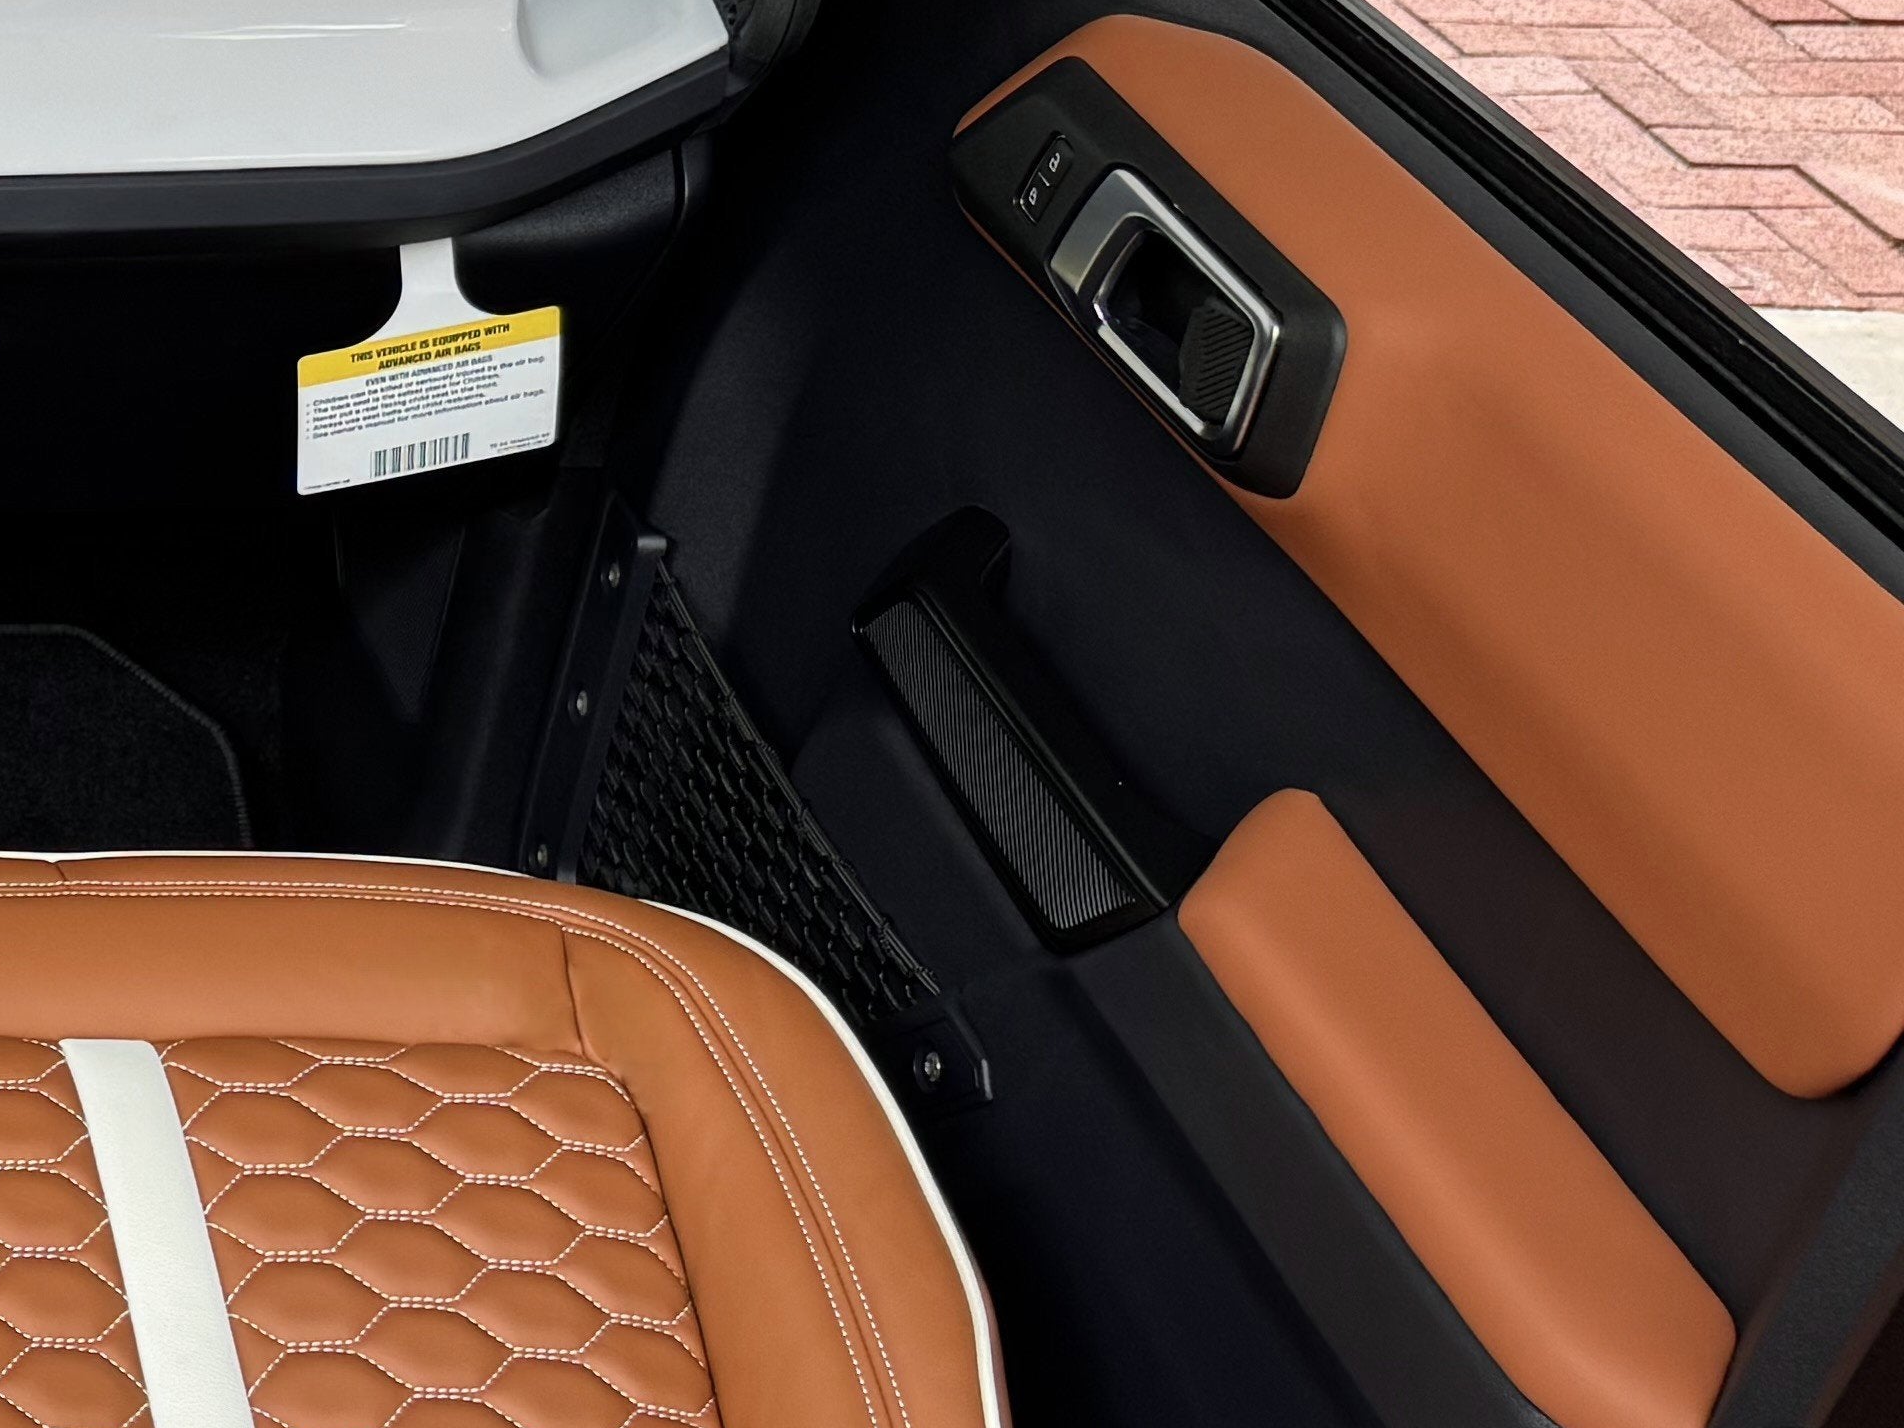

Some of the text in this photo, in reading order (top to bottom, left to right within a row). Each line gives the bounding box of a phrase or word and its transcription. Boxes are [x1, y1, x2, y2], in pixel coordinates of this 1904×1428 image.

[351, 350, 373, 362] THIS
[375, 341, 416, 357] VEHICLE
[432, 329, 480, 346] EQUIPPED
[484, 323, 509, 336] WITH
[378, 341, 480, 369] ADVANCED AIR BAGS
[365, 354, 492, 386] EVEN WITH ADVANCED AIR BAGS
